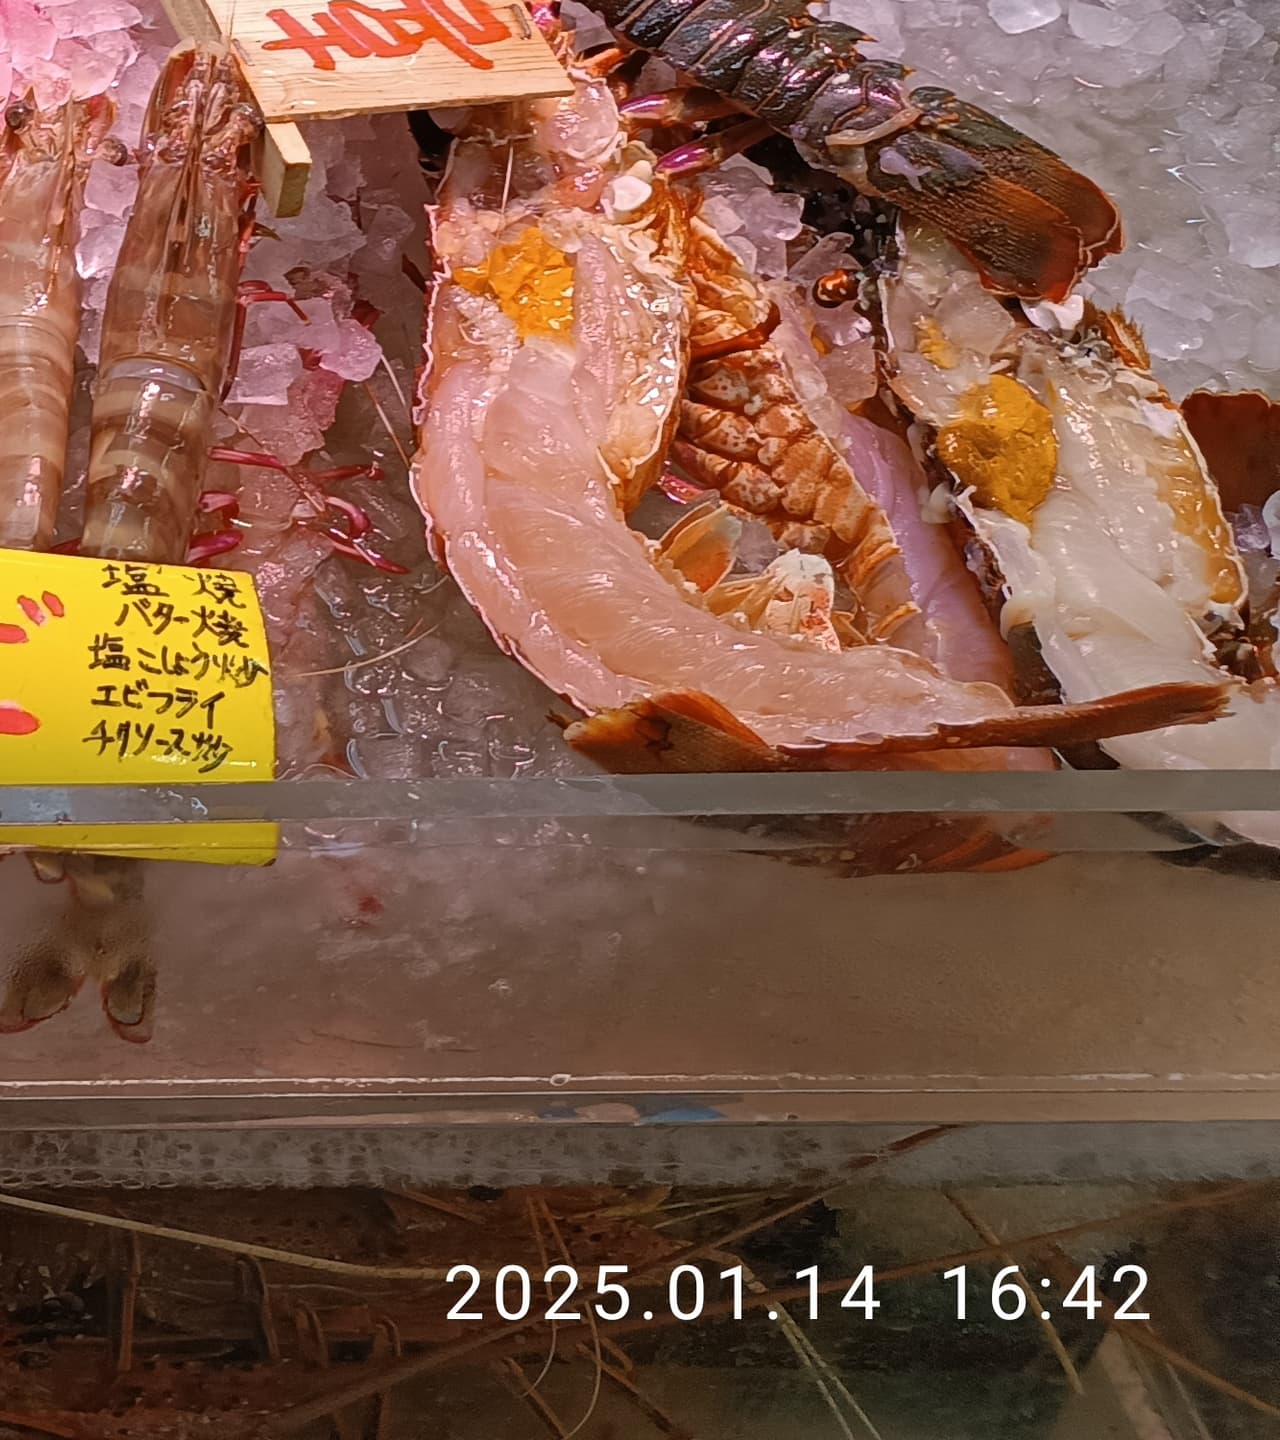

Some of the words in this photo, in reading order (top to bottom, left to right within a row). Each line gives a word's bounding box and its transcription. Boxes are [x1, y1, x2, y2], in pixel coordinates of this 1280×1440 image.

[114, 597, 250, 648] バター焼
[91, 678, 225, 730] エビフライ
